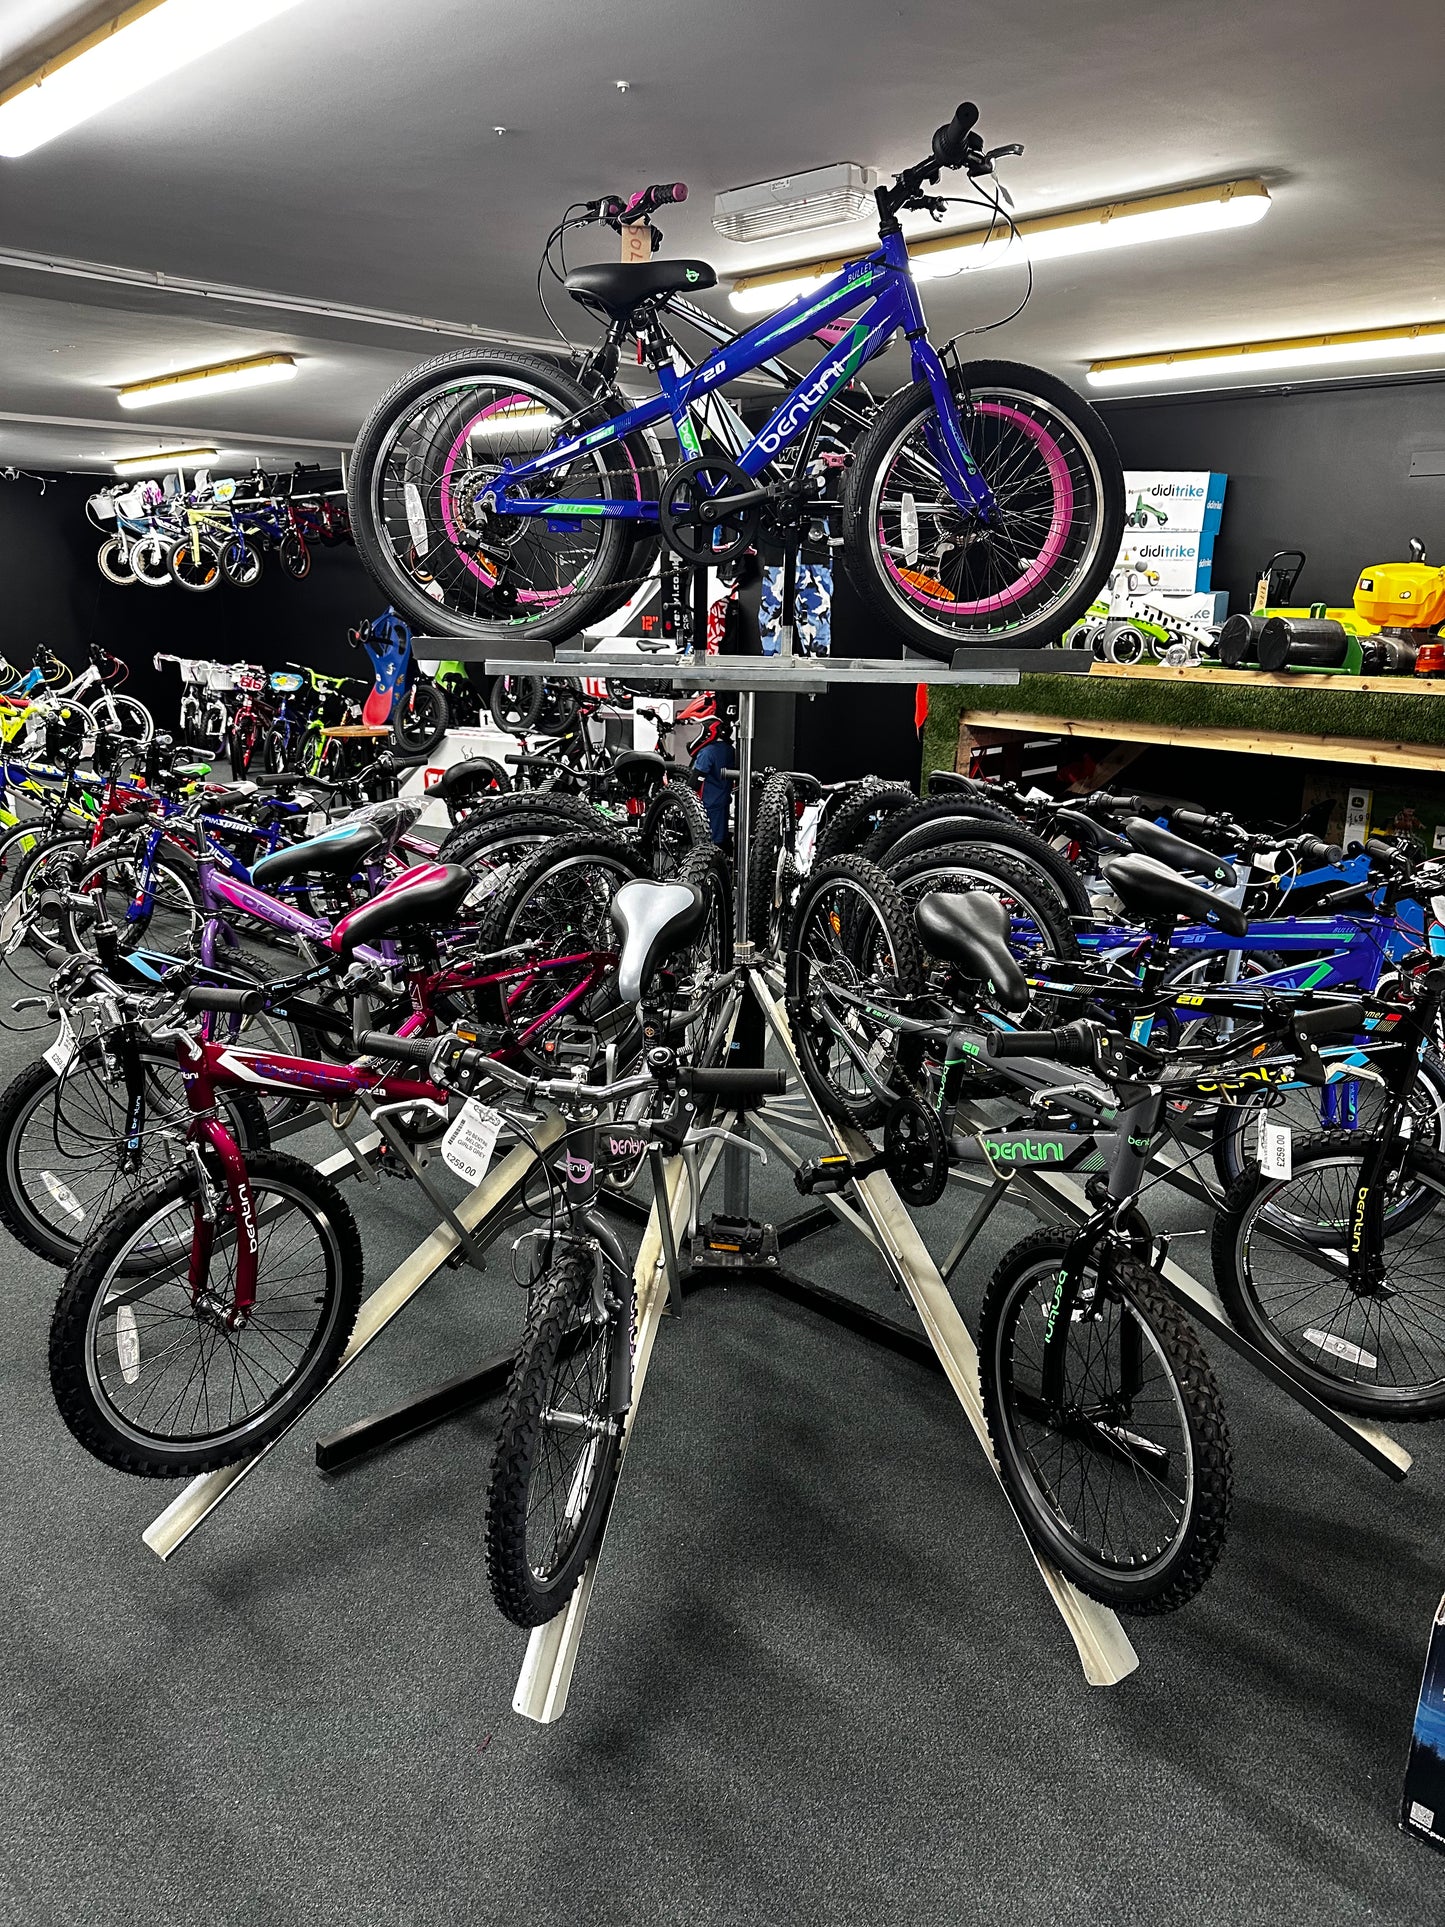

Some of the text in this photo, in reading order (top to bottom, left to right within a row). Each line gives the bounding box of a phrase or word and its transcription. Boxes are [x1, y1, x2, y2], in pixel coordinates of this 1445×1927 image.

[847, 262, 872, 283] BULLET
[703, 360, 727, 383] 20
[758, 361, 846, 454] bentini
[1152, 484, 1204, 497] diditrike
[1139, 545, 1196, 558] diditrike
[641, 615, 659, 631] 12"
[1182, 934, 1206, 944] 20
[1176, 994, 1205, 1006] 20
[272, 1007, 288, 1017] 20
[961, 1040, 981, 1057] 20
[472, 1147, 486, 1159] GREY
[985, 1138, 1065, 1161] bentini
[1276, 1134, 1286, 1168] £259.00
[446, 1152, 477, 1177] £259.00
[238, 1183, 258, 1254] bentini
[1351, 1187, 1369, 1253] bentini
[1044, 1269, 1068, 1344] bentini
